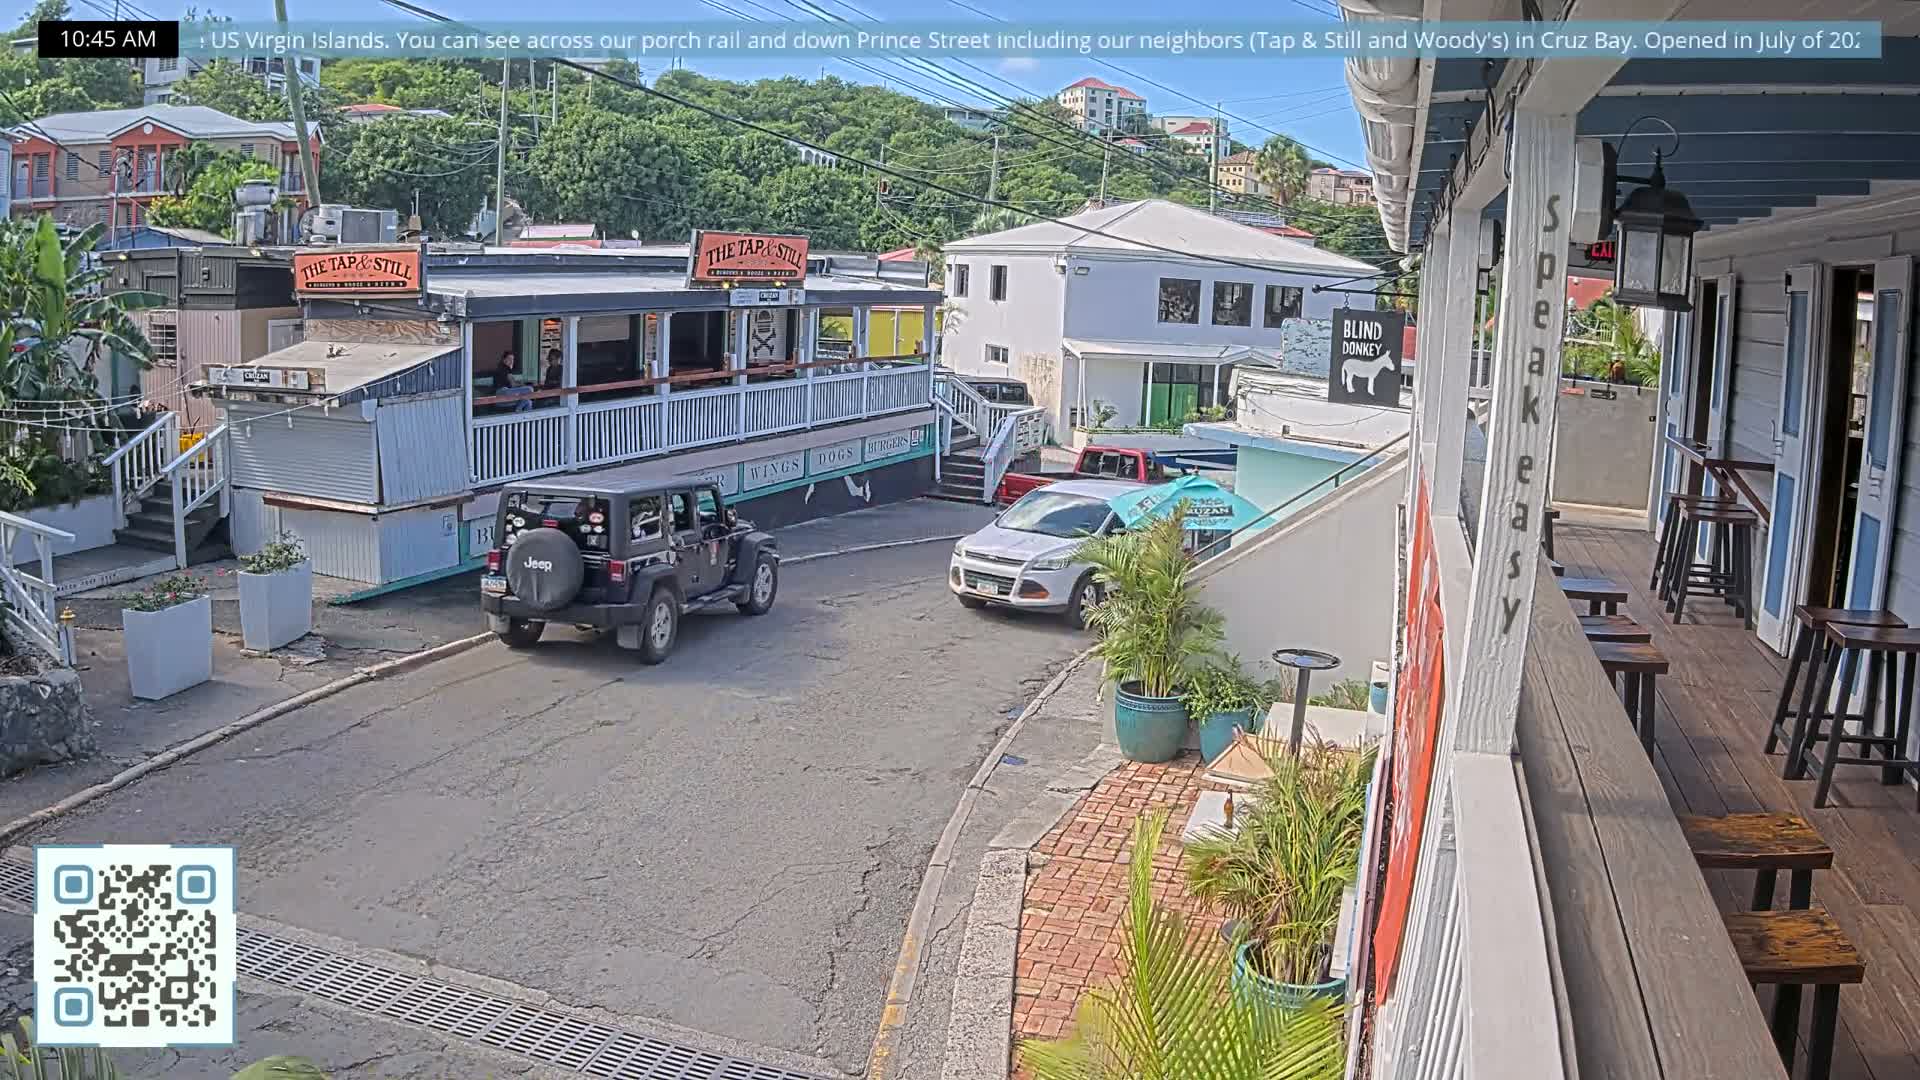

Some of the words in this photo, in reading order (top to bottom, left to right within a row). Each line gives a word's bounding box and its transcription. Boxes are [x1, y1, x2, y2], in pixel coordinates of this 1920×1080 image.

[706, 243, 736, 267] THE
[738, 239, 765, 258] TAP
[762, 240, 777, 258] &
[778, 243, 802, 269] STILL
[1591, 240, 1613, 257] EXI
[301, 260, 328, 281] THE
[328, 255, 357, 271] TAP
[356, 254, 372, 272] &
[373, 257, 412, 281] STILL
[1343, 319, 1383, 341] BLIND
[1342, 341, 1383, 356] DONKEY
[244, 372, 269, 380] CRUZAN
[867, 436, 909, 453] BURGERS
[818, 447, 854, 465] DOGS
[750, 458, 799, 481] WINGS
[523, 556, 553, 572] Jeep
